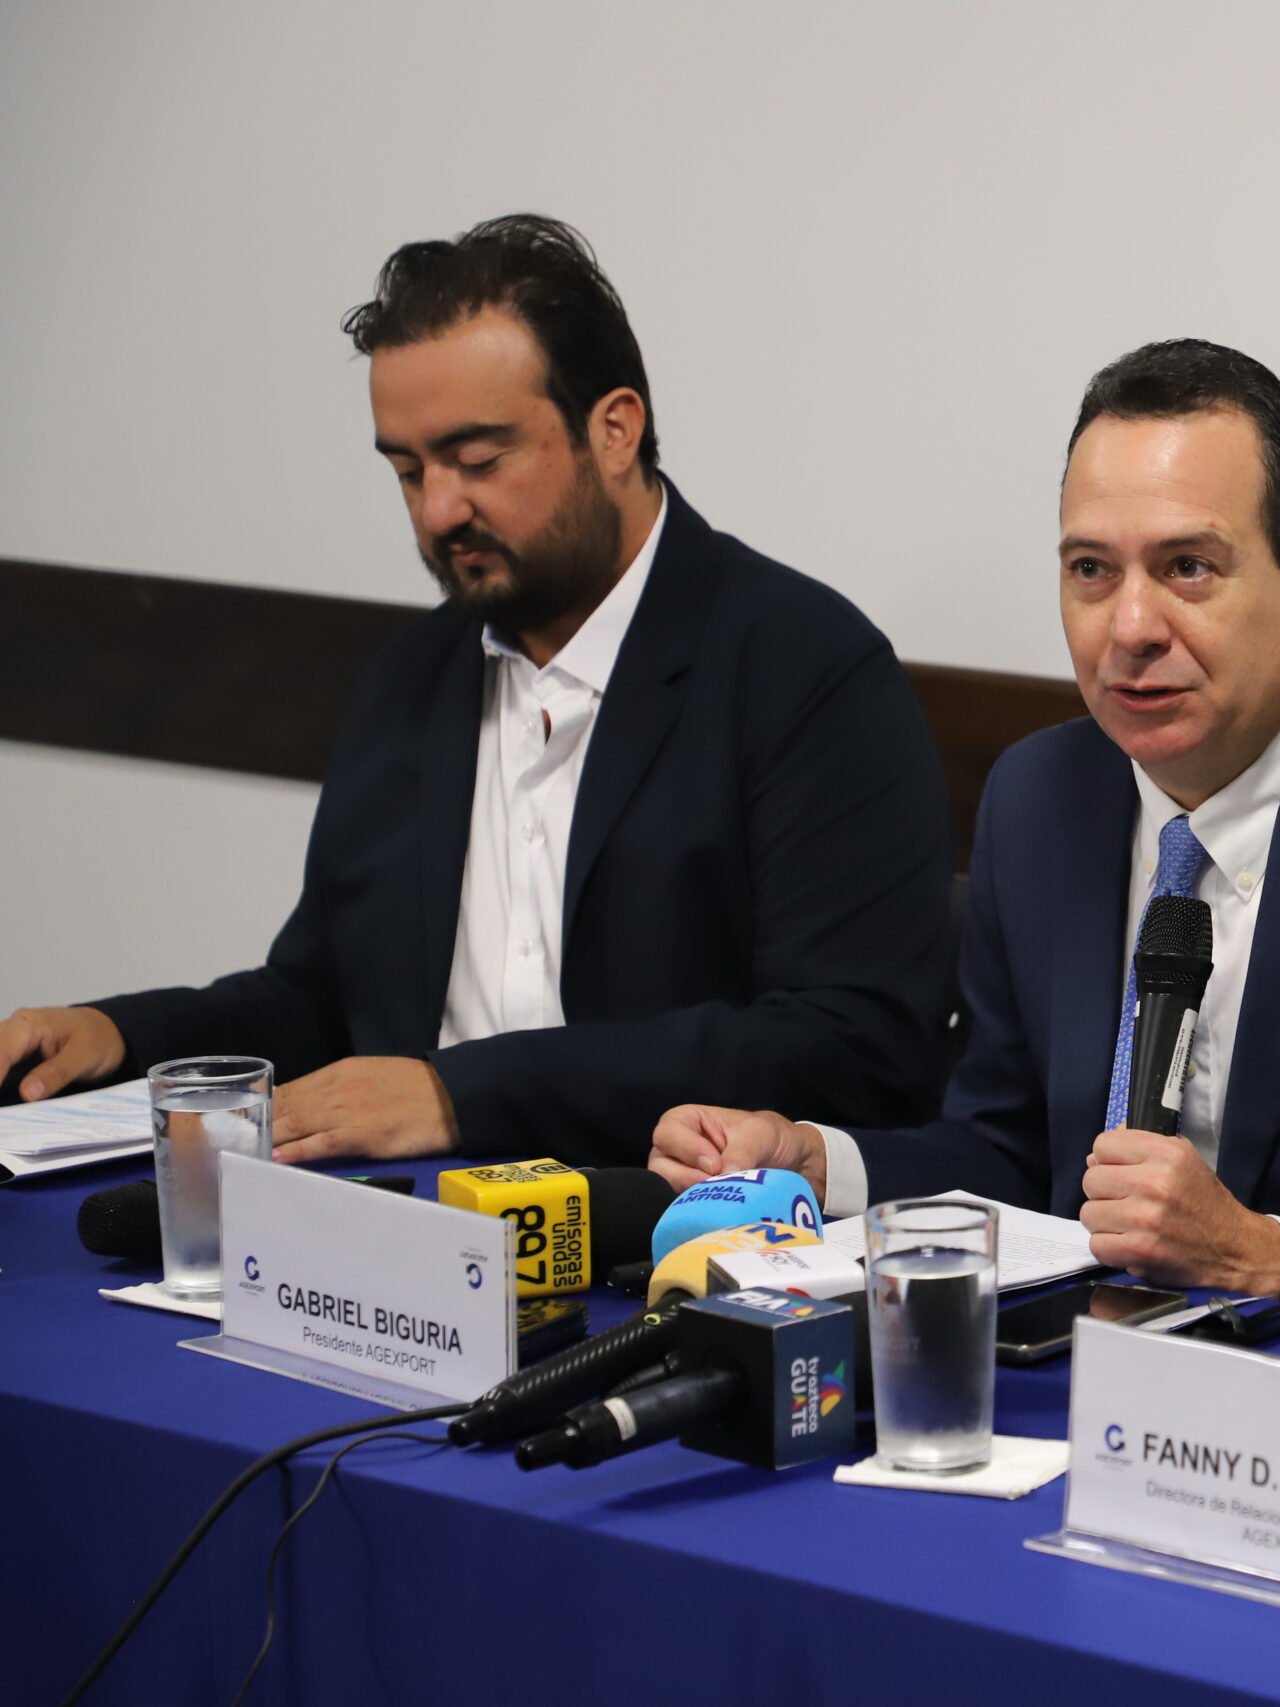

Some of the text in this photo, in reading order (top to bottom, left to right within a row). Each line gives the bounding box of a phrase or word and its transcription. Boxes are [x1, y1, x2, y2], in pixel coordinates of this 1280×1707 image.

[673, 1193, 746, 1205] ANTIGUA
[688, 1186, 744, 1195] CANAL
[552, 1223, 570, 1287] unidas
[567, 1195, 586, 1286] emisoras
[278, 1283, 463, 1355] GABRIEL BIGURIA
[303, 1326, 437, 1377] Presidente AGEXPORT
[1143, 1433, 1241, 1481] FANNY
[1251, 1457, 1277, 1491] D.
[1146, 1481, 1206, 1508] Directora
[1210, 1497, 1226, 1513] de
